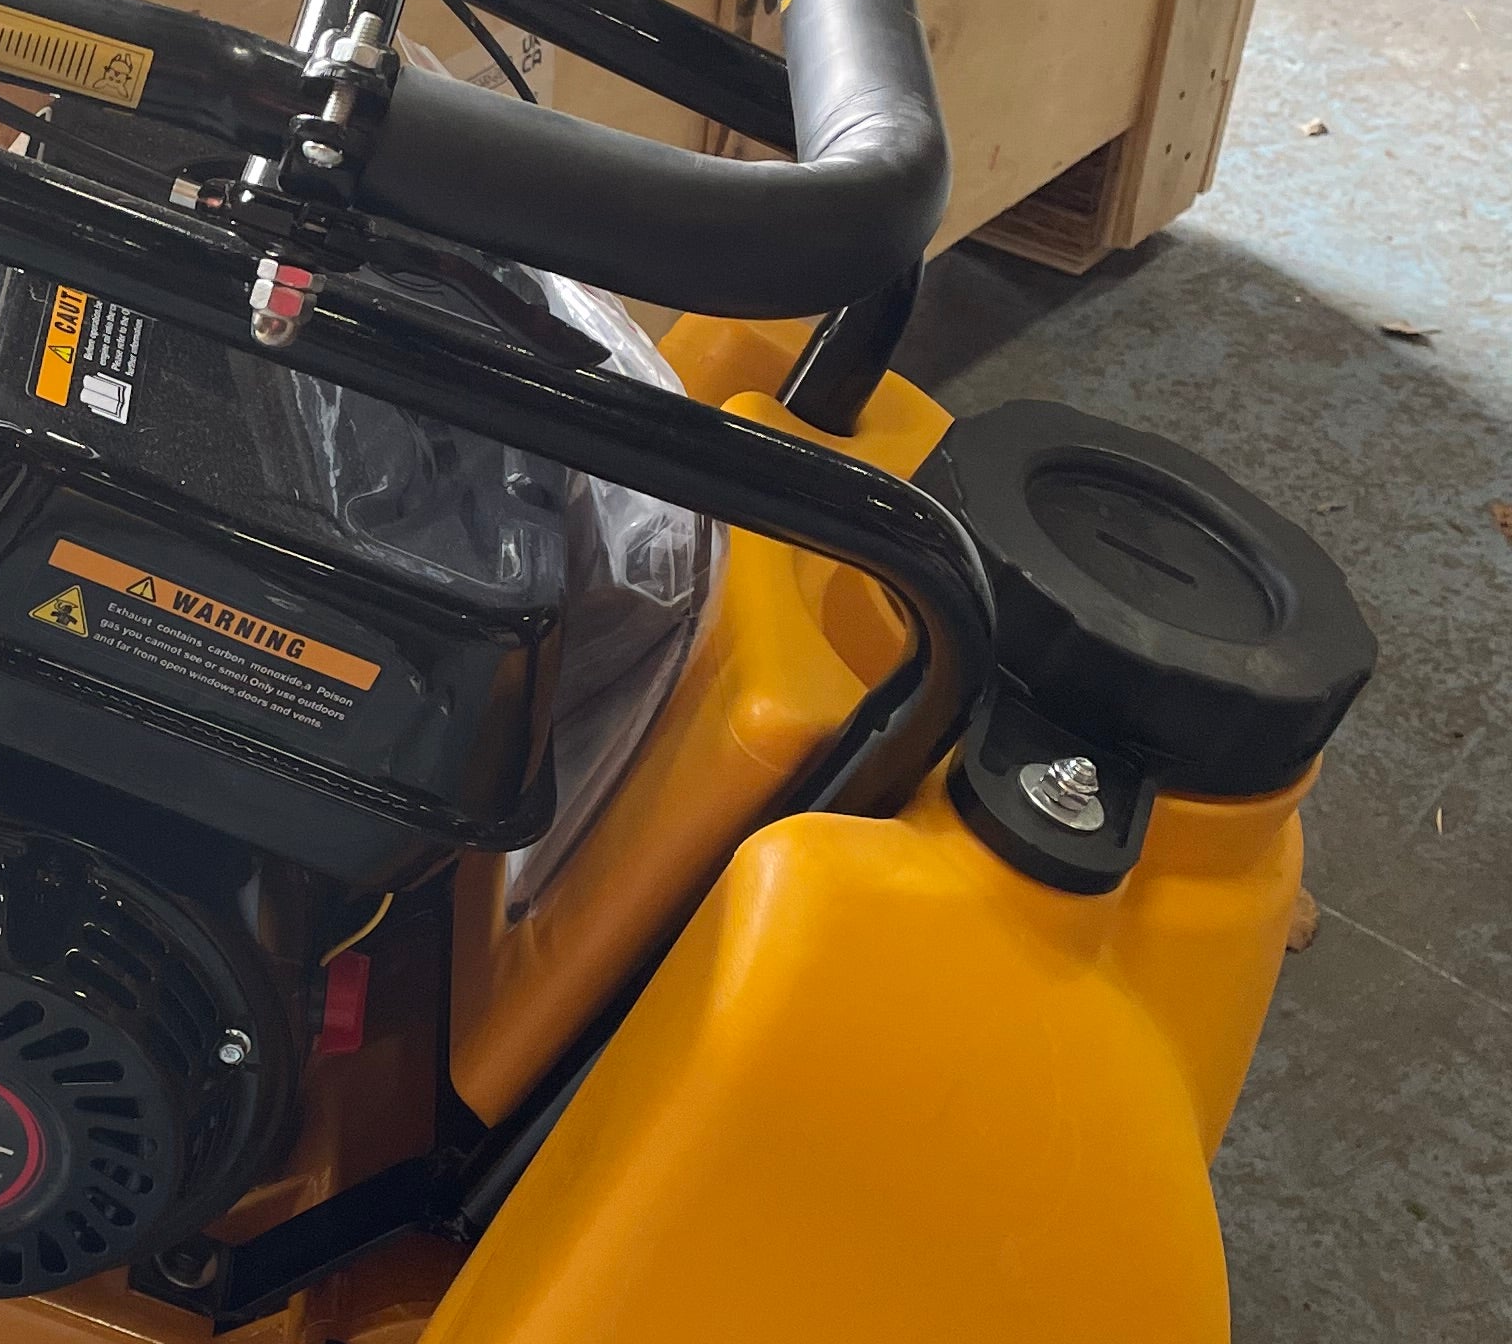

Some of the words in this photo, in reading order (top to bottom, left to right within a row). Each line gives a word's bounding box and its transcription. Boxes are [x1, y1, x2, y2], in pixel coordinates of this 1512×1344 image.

[54, 289, 83, 334] CAUT
[99, 616, 120, 633] gas
[121, 625, 142, 642] you
[144, 636, 182, 655] cannot
[183, 649, 204, 664] see
[204, 660, 217, 670] or
[275, 685, 297, 701] use
[297, 697, 346, 720] outdoors
[106, 602, 152, 626] Exhaust
[156, 623, 202, 647] contains
[207, 642, 245, 664] carbon
[316, 686, 353, 706] Poison
[172, 590, 306, 660] WARNING
[92, 632, 115, 646] and
[113, 640, 132, 653] far
[131, 646, 158, 662] from
[159, 658, 186, 674] open
[269, 703, 291, 715] and
[292, 711, 322, 729] vents.
